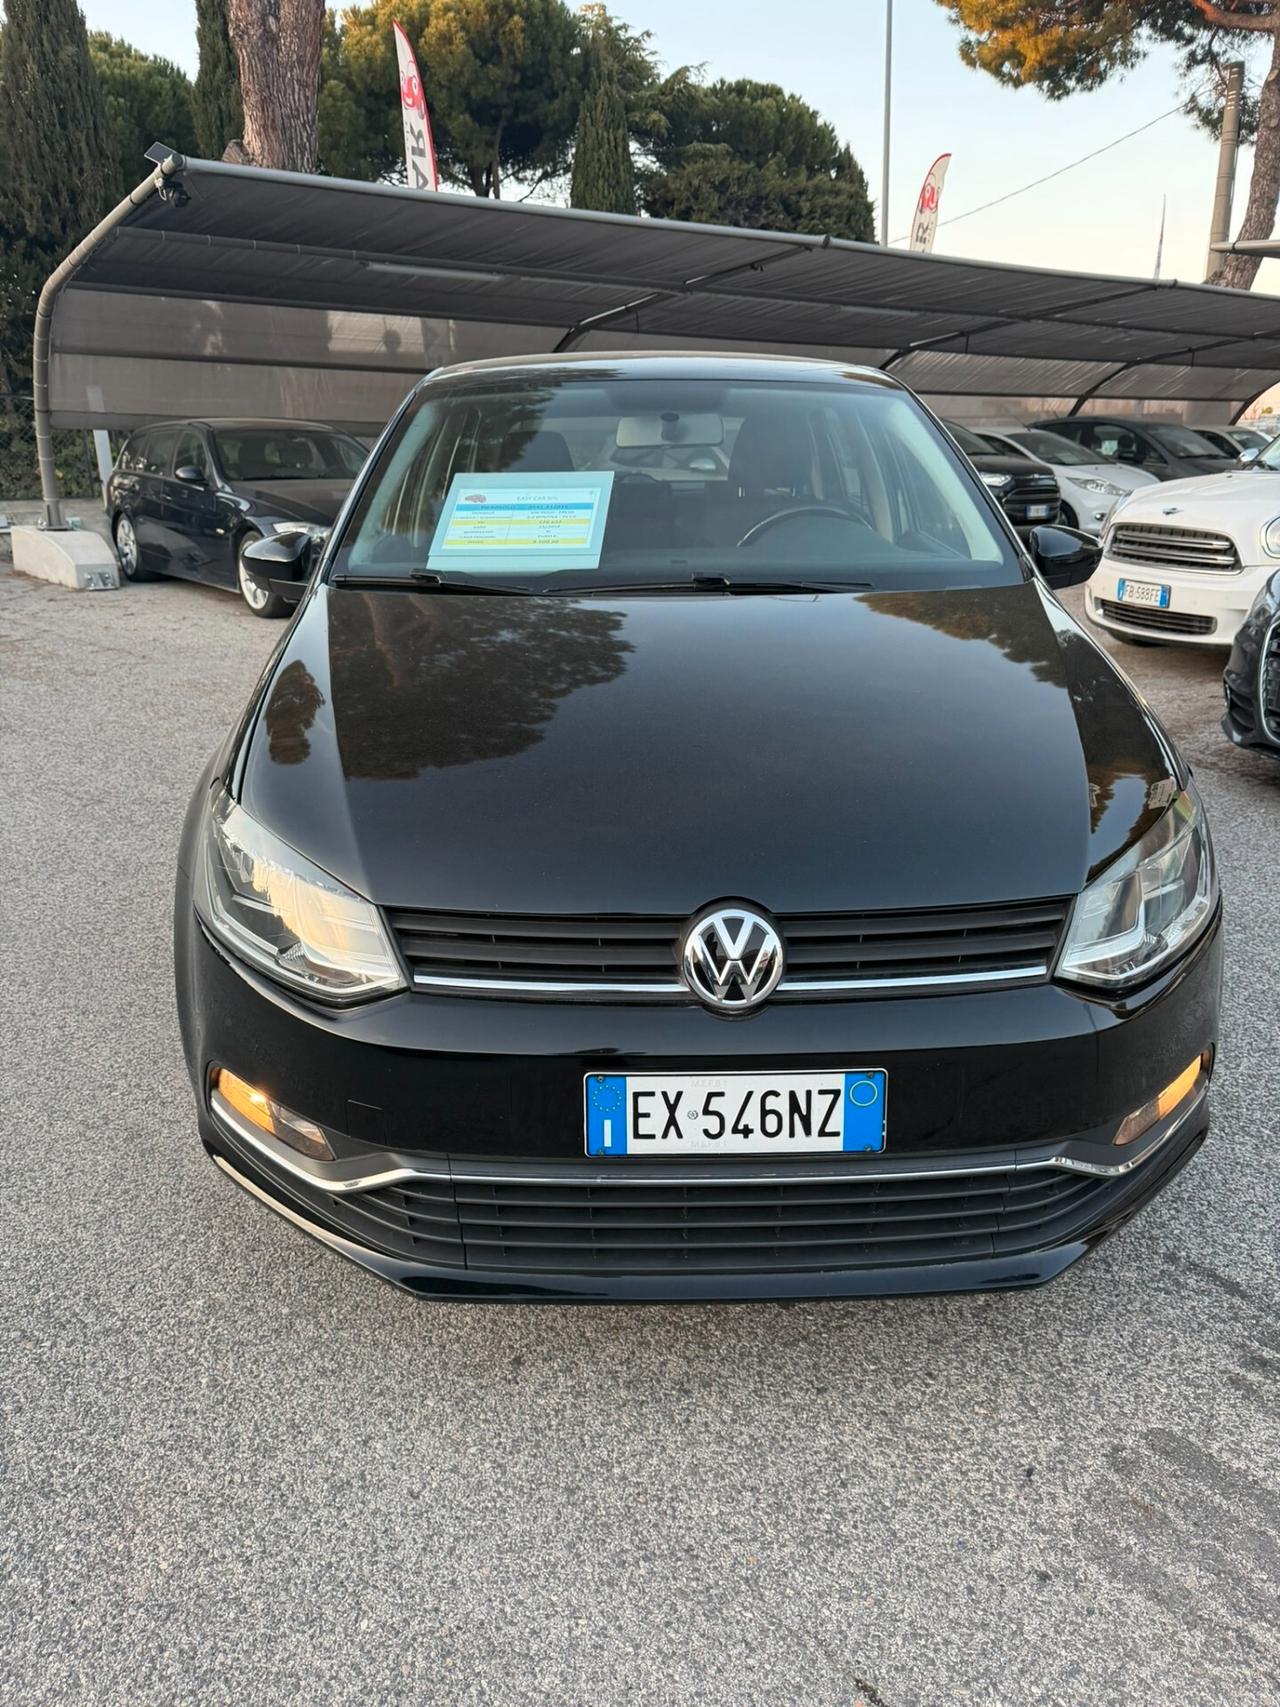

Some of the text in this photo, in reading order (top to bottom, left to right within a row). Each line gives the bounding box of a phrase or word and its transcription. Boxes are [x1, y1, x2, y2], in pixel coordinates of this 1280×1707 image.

[684, 908, 783, 1006] VW
[632, 1089, 842, 1140] EX 546NZ
